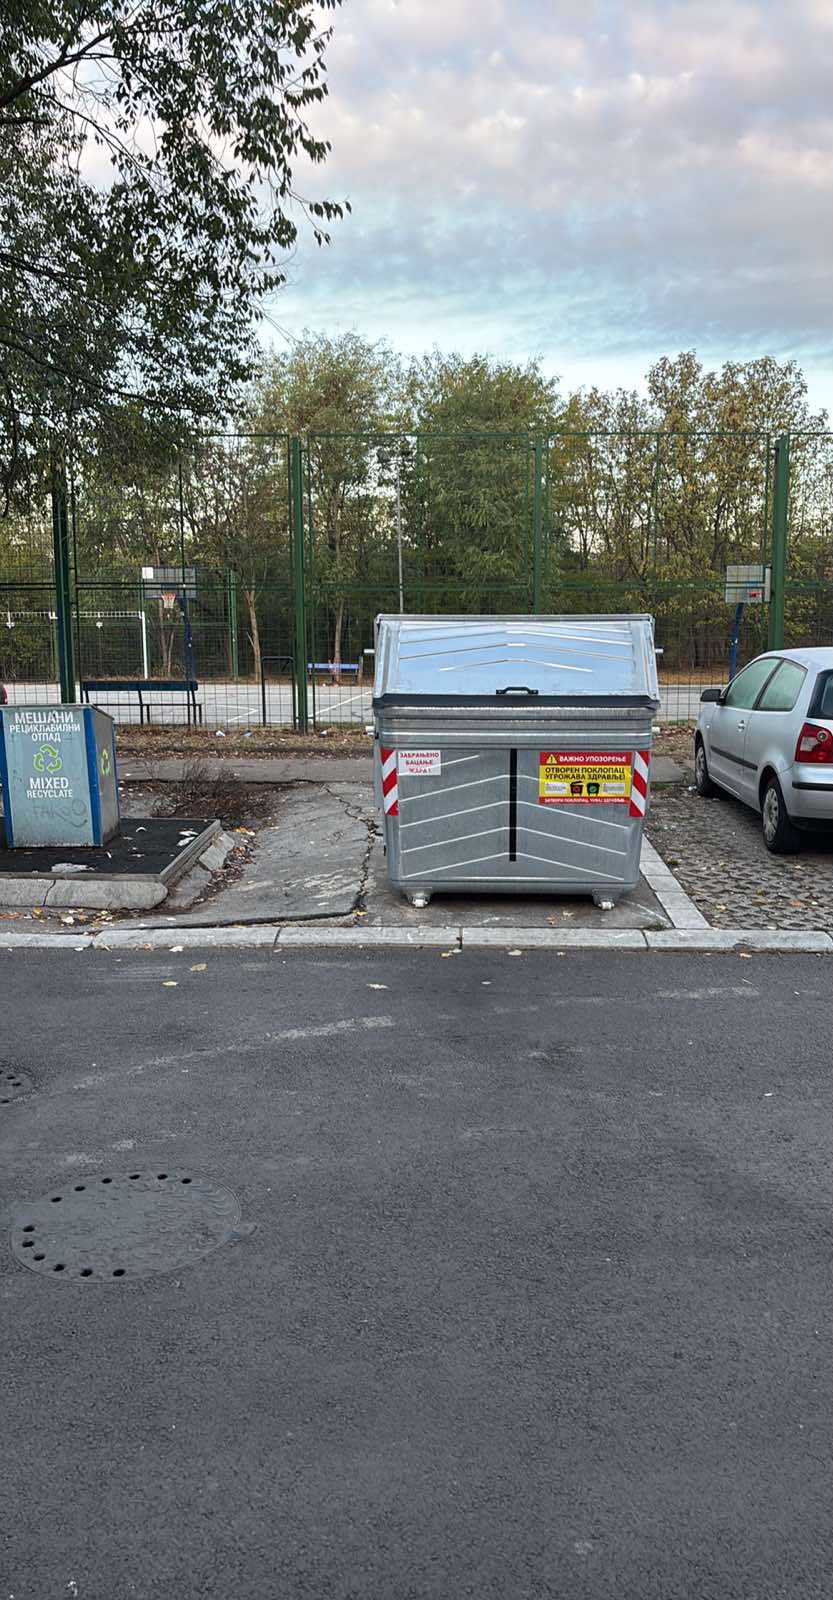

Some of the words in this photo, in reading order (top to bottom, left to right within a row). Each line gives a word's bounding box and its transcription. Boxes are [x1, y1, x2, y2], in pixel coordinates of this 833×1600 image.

[14, 711, 74, 724] МЕШАНИ
[9, 724, 81, 733] РЕЦИКЛАБИЛНИ
[31, 733, 61, 742] ОТПАД
[29, 777, 69, 789] MIXED
[26, 789, 73, 798] RECYCLATE
